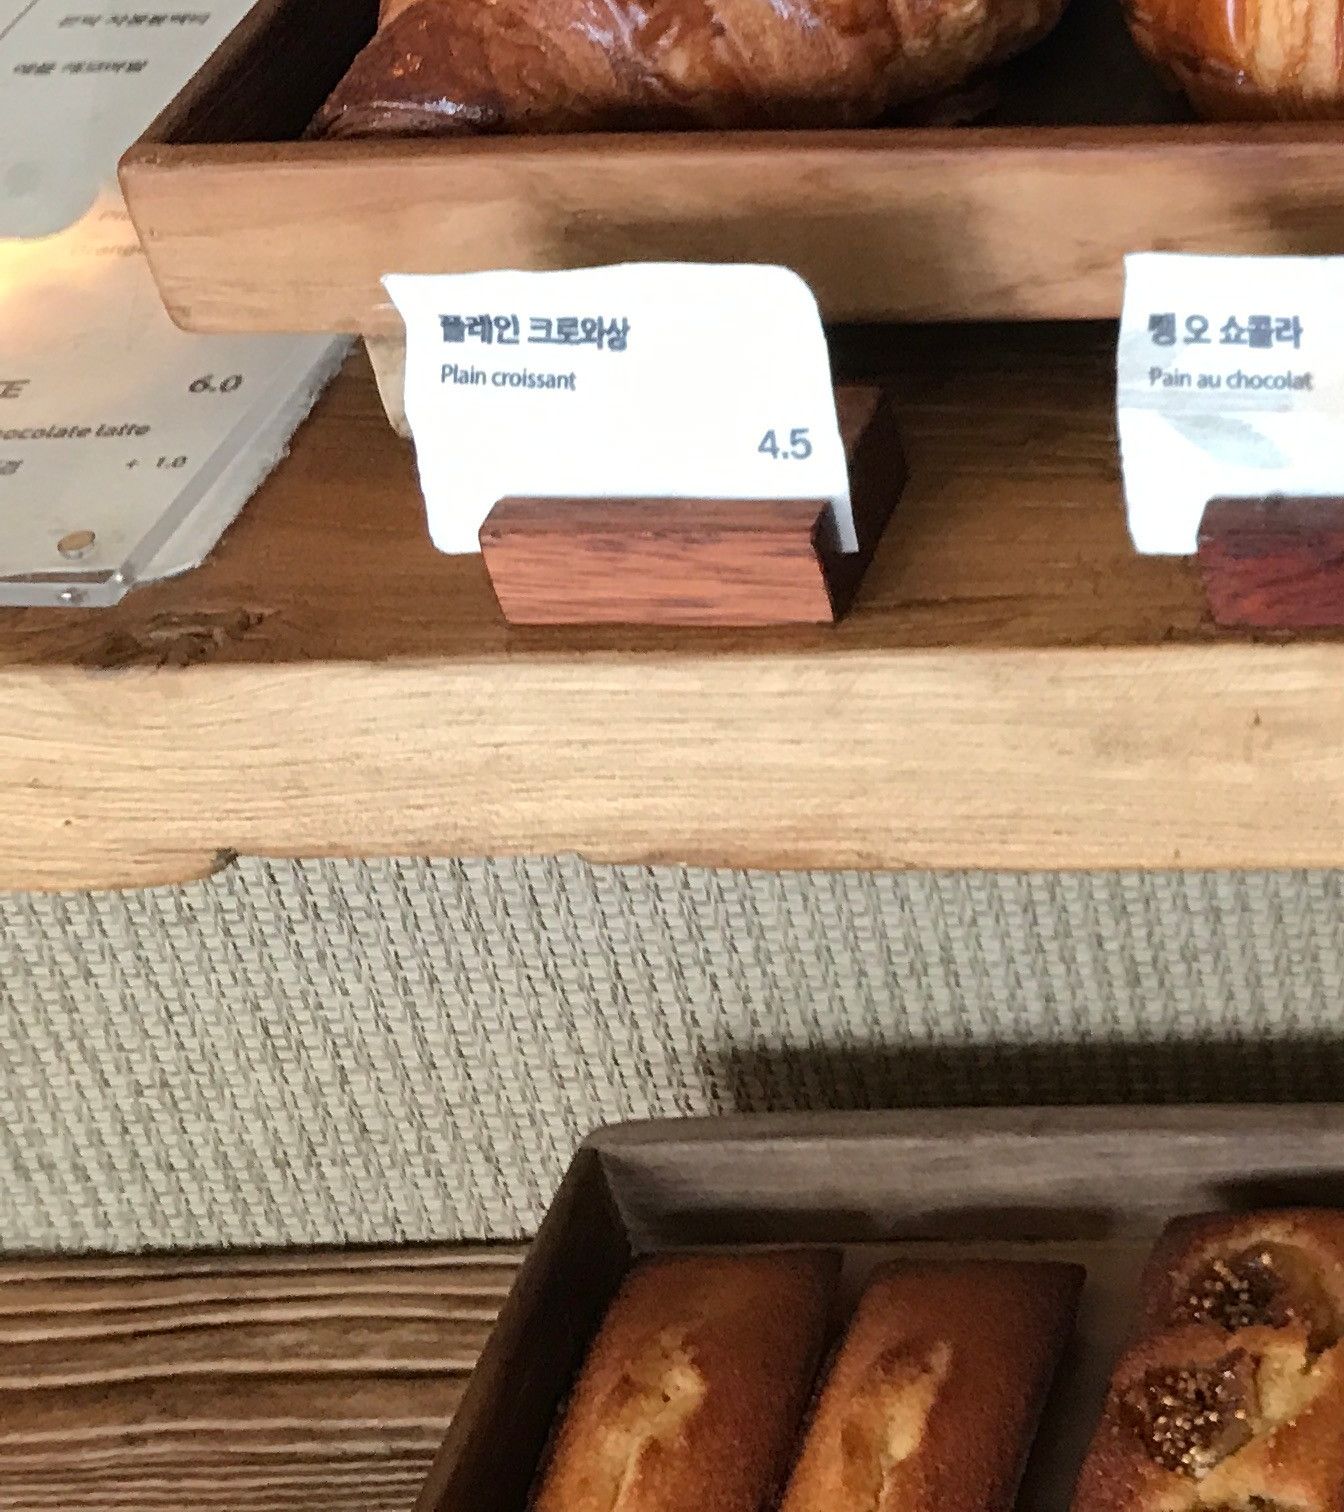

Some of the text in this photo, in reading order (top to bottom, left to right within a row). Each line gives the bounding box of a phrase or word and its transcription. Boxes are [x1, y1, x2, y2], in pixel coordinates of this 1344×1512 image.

[438, 313, 633, 354] 플레인 크로와상
[1182, 314, 1213, 347] 오
[1219, 314, 1305, 351] 쇼콜라
[188, 373, 243, 394] 6.0
[440, 363, 578, 393] Plain croissant
[1147, 366, 1316, 393] Pain au chocolat
[95, 423, 151, 438] latte
[757, 427, 814, 461] 4.5
